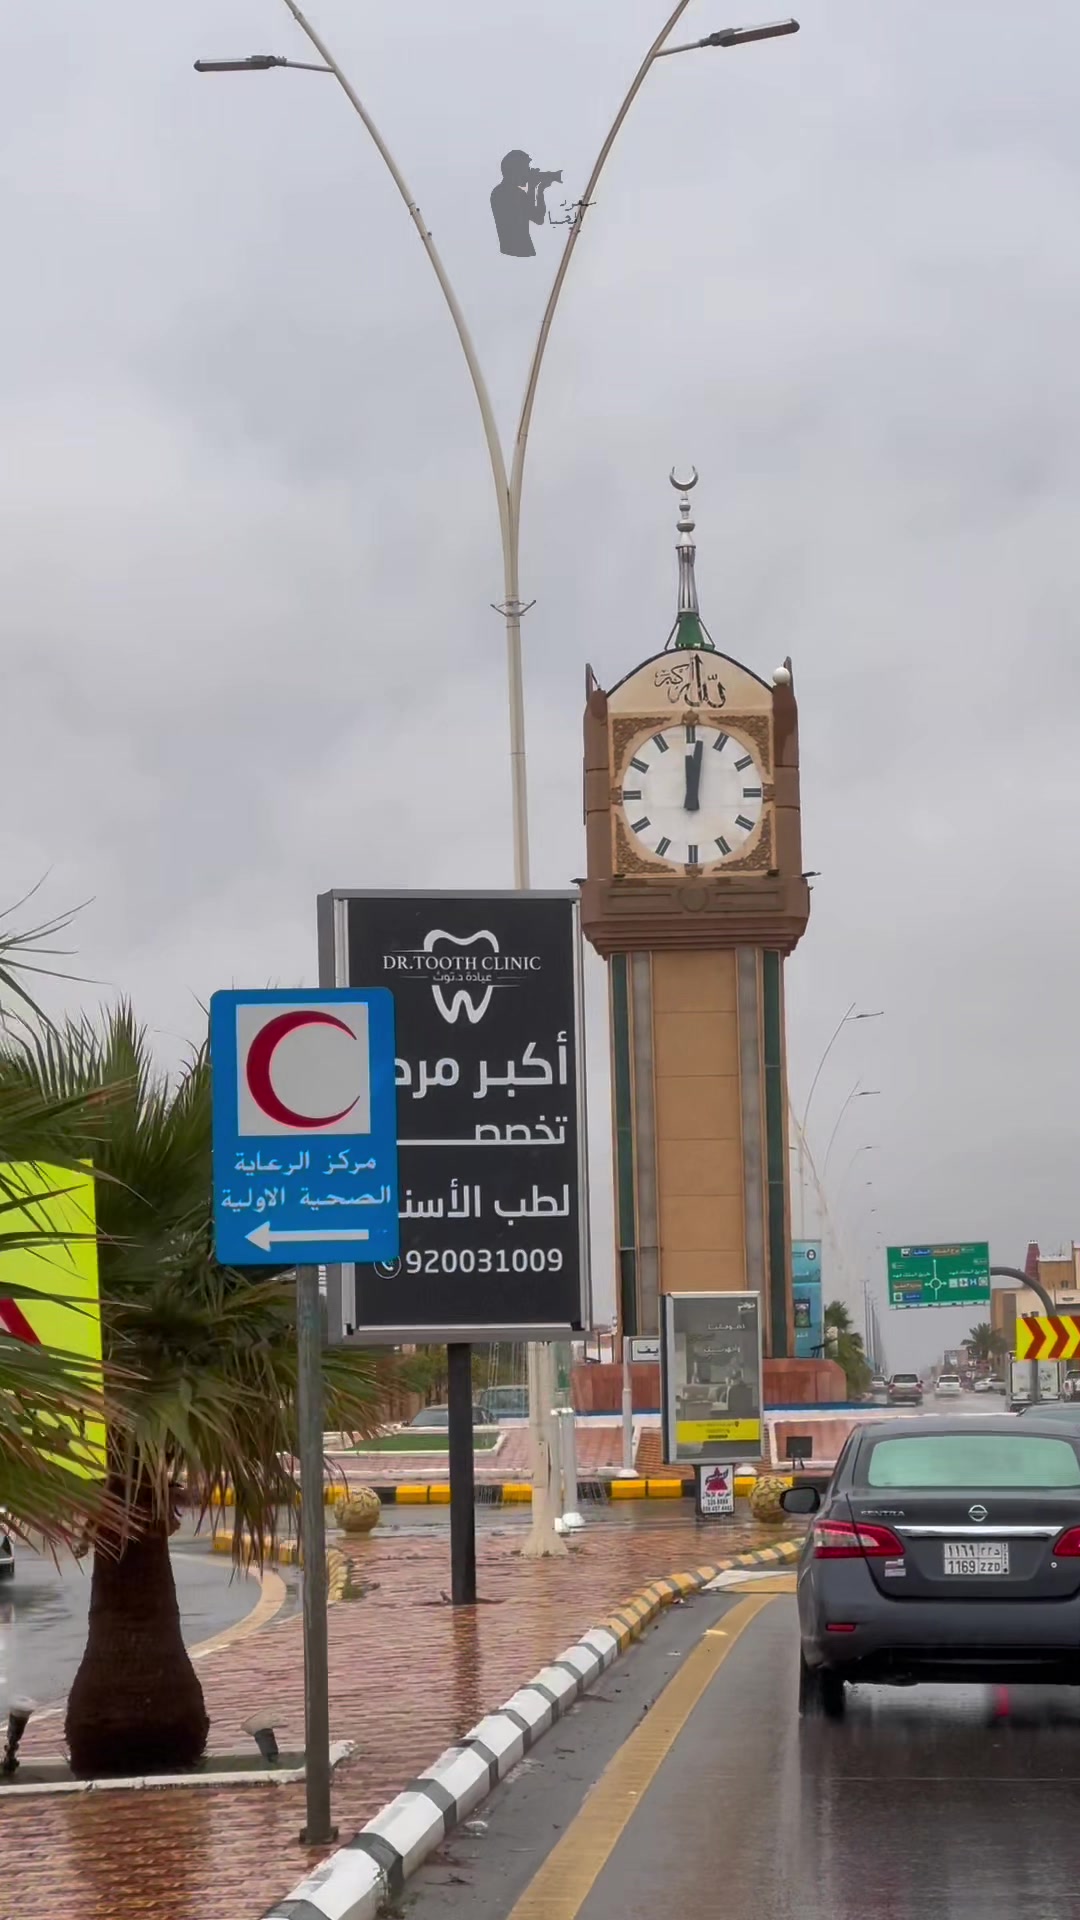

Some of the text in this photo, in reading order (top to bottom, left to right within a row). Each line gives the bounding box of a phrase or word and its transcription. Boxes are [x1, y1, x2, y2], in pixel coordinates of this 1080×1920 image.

[383, 955, 542, 971] DR.TOOTH CLINIC
[465, 972, 492, 984] عيادة
[473, 1031, 568, 1099] أكبر
[396, 1115, 568, 1146] تخصص
[234, 1148, 377, 1176] مركز الرعاية
[299, 1184, 392, 1211] الصحية
[398, 1178, 570, 1226] لطب الأسن
[405, 1248, 564, 1274] 920031009
[948, 1560, 1001, 1573] 1169 ZZD
